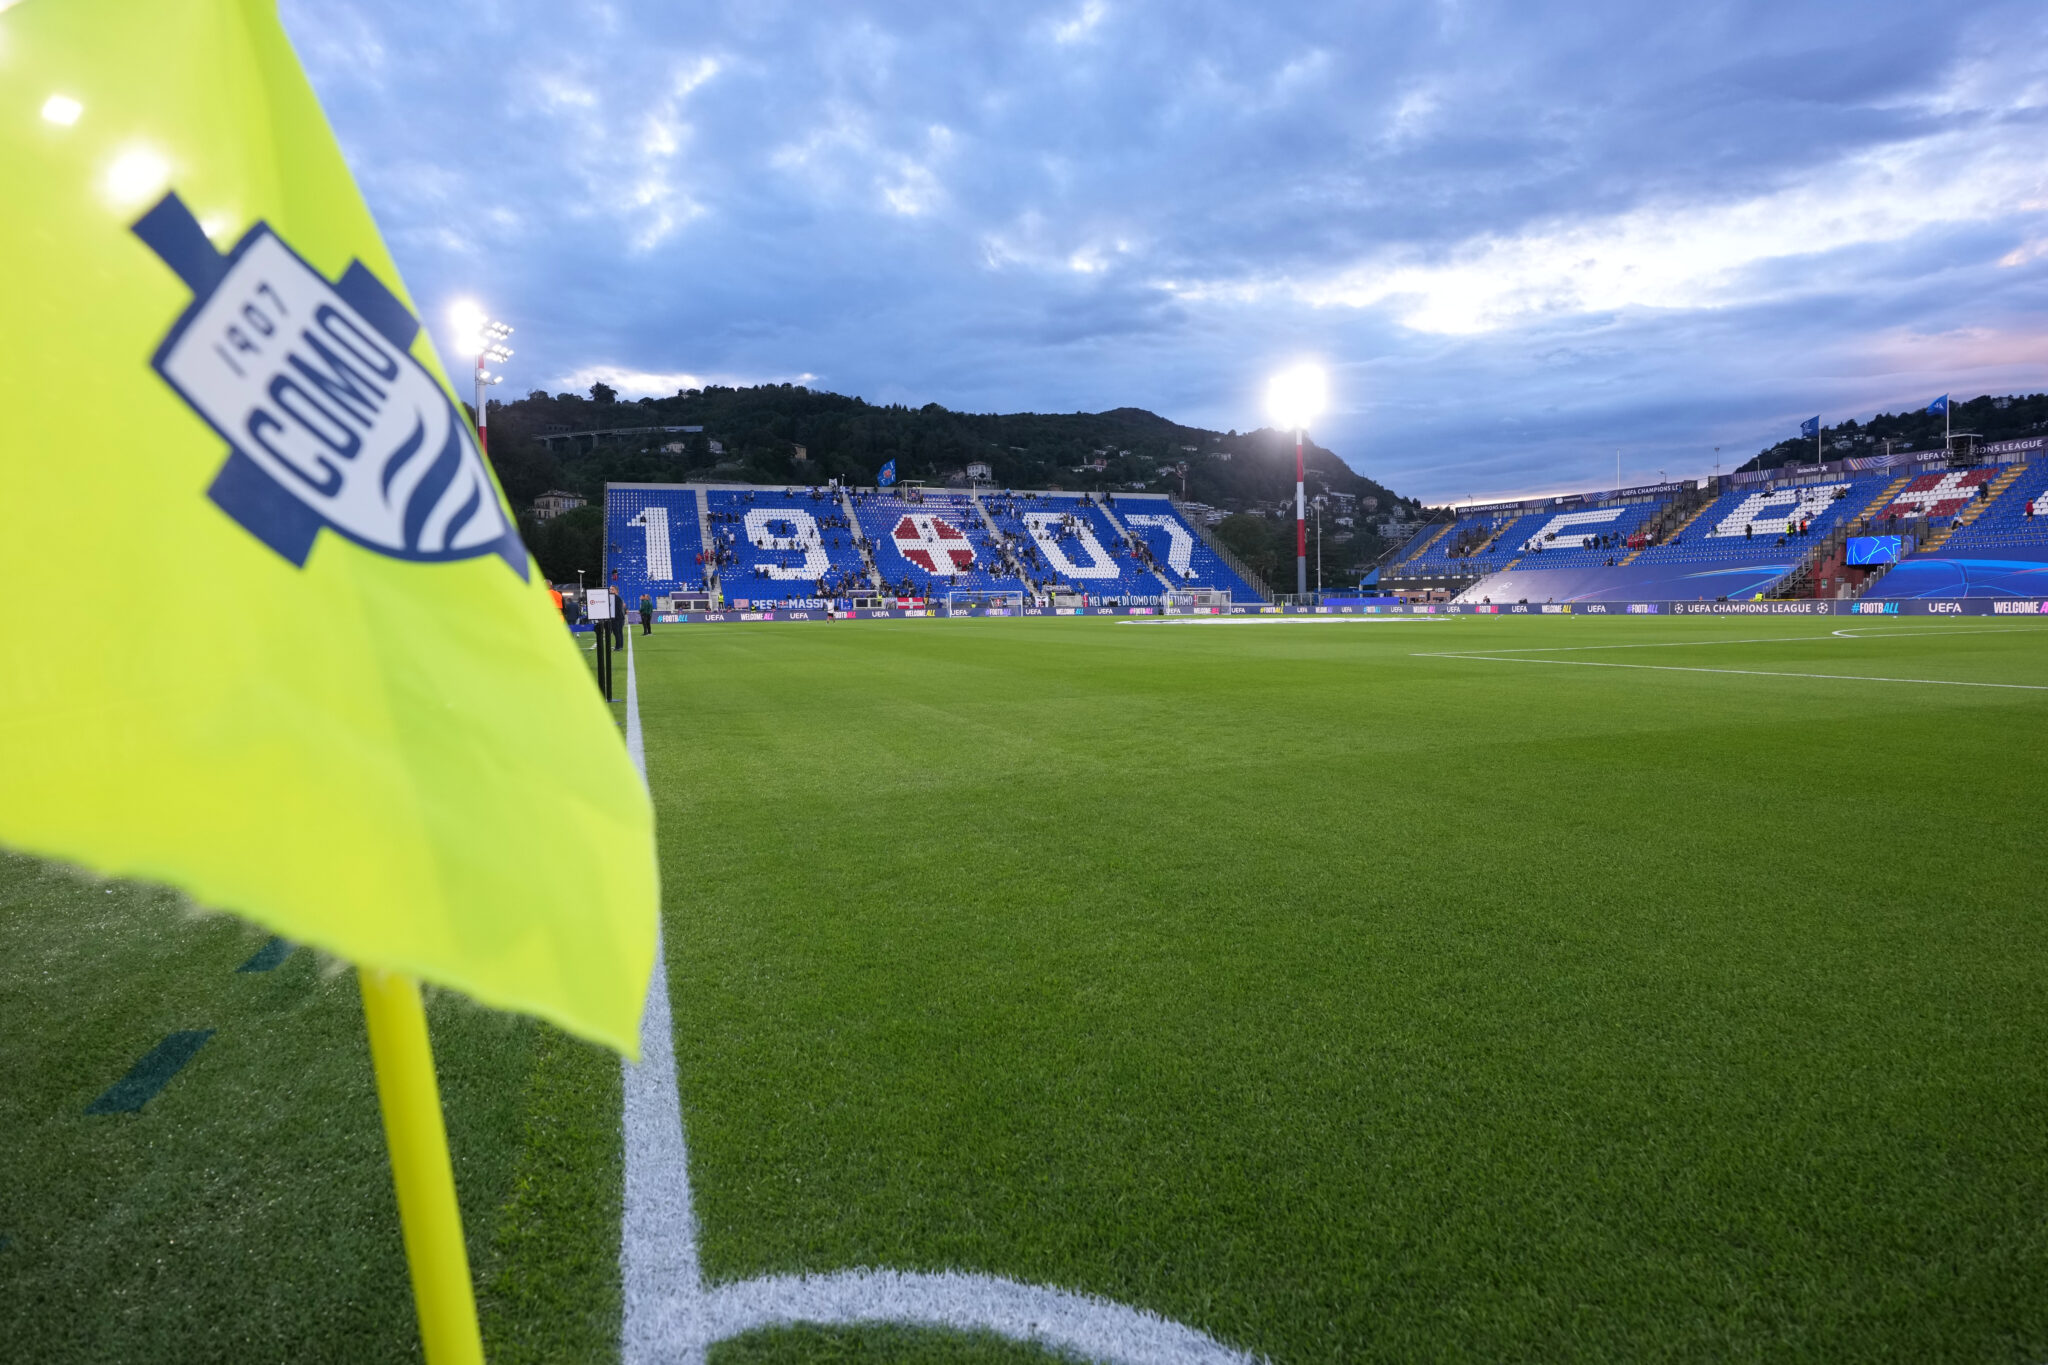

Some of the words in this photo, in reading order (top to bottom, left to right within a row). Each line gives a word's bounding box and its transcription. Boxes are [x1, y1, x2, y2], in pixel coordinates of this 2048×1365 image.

[213, 281, 289, 379] 1907
[245, 304, 399, 499] COMO
[1916, 453, 1939, 461] UEFA
[2002, 440, 2043, 452] LEAGUE
[1637, 485, 1671, 495] CHAMPIONS
[1470, 504, 1499, 512] CHAMPIONS
[1088, 596, 1101, 606] NEL
[1130, 595, 1149, 606] COMO
[1511, 605, 1528, 613] UEFA
[1541, 604, 1563, 614] WELCOME
[1562, 604, 1572, 614] ALL
[1587, 604, 1606, 613] UEFA
[1626, 604, 1658, 614] #FOOTBALL
[1687, 604, 1711, 613] UEFA
[1713, 604, 1769, 613] CHAMPIONS
[1772, 604, 1812, 613] LEAGUE
[1851, 602, 1899, 614] #FOOTBALL
[1928, 602, 1962, 613] UEFA
[1994, 602, 2039, 614] WELCOME
[657, 614, 688, 623] #FOOTBALL
[740, 612, 763, 620] WELCOME
[763, 612, 774, 620] ALL
